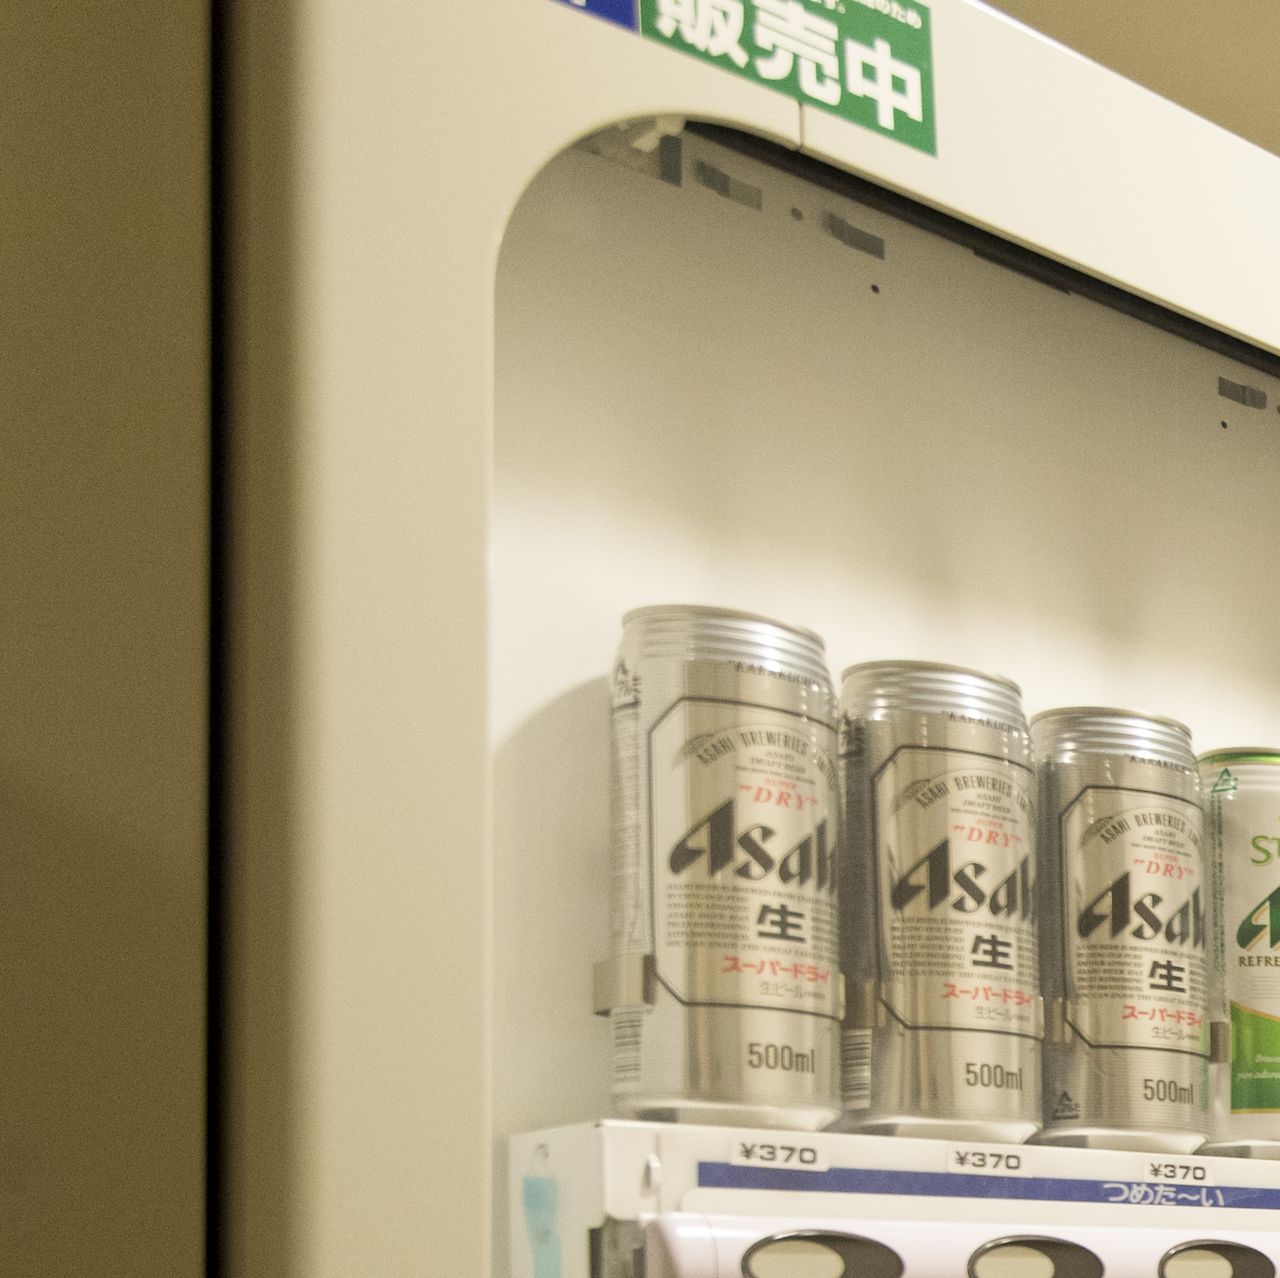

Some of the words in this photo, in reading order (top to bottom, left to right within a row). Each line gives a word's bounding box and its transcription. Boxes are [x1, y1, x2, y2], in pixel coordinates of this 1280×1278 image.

[655, 0, 922, 131] 販売中
[740, 731, 808, 757] BREWERIES
[954, 775, 1013, 796] BREWERIES
[1100, 820, 1131, 845] ASAHI
[1134, 813, 1186, 833] BREWERIES
[669, 797, 838, 895] Asah
[890, 837, 1037, 926] Asah
[756, 903, 806, 944] 生
[1077, 872, 1206, 949] Asah
[971, 934, 1015, 971] 生
[721, 956, 830, 983] スーパードライ
[1148, 960, 1187, 994] 生
[943, 982, 1034, 1006] スーパードライ
[748, 1042, 816, 1074] 500ml
[966, 1063, 1023, 1090] 500ml
[1143, 1079, 1194, 1105] 500ml
[738, 1141, 817, 1165] ¥370
[954, 1149, 1022, 1170] ¥370
[1150, 1163, 1207, 1182] ¥370
